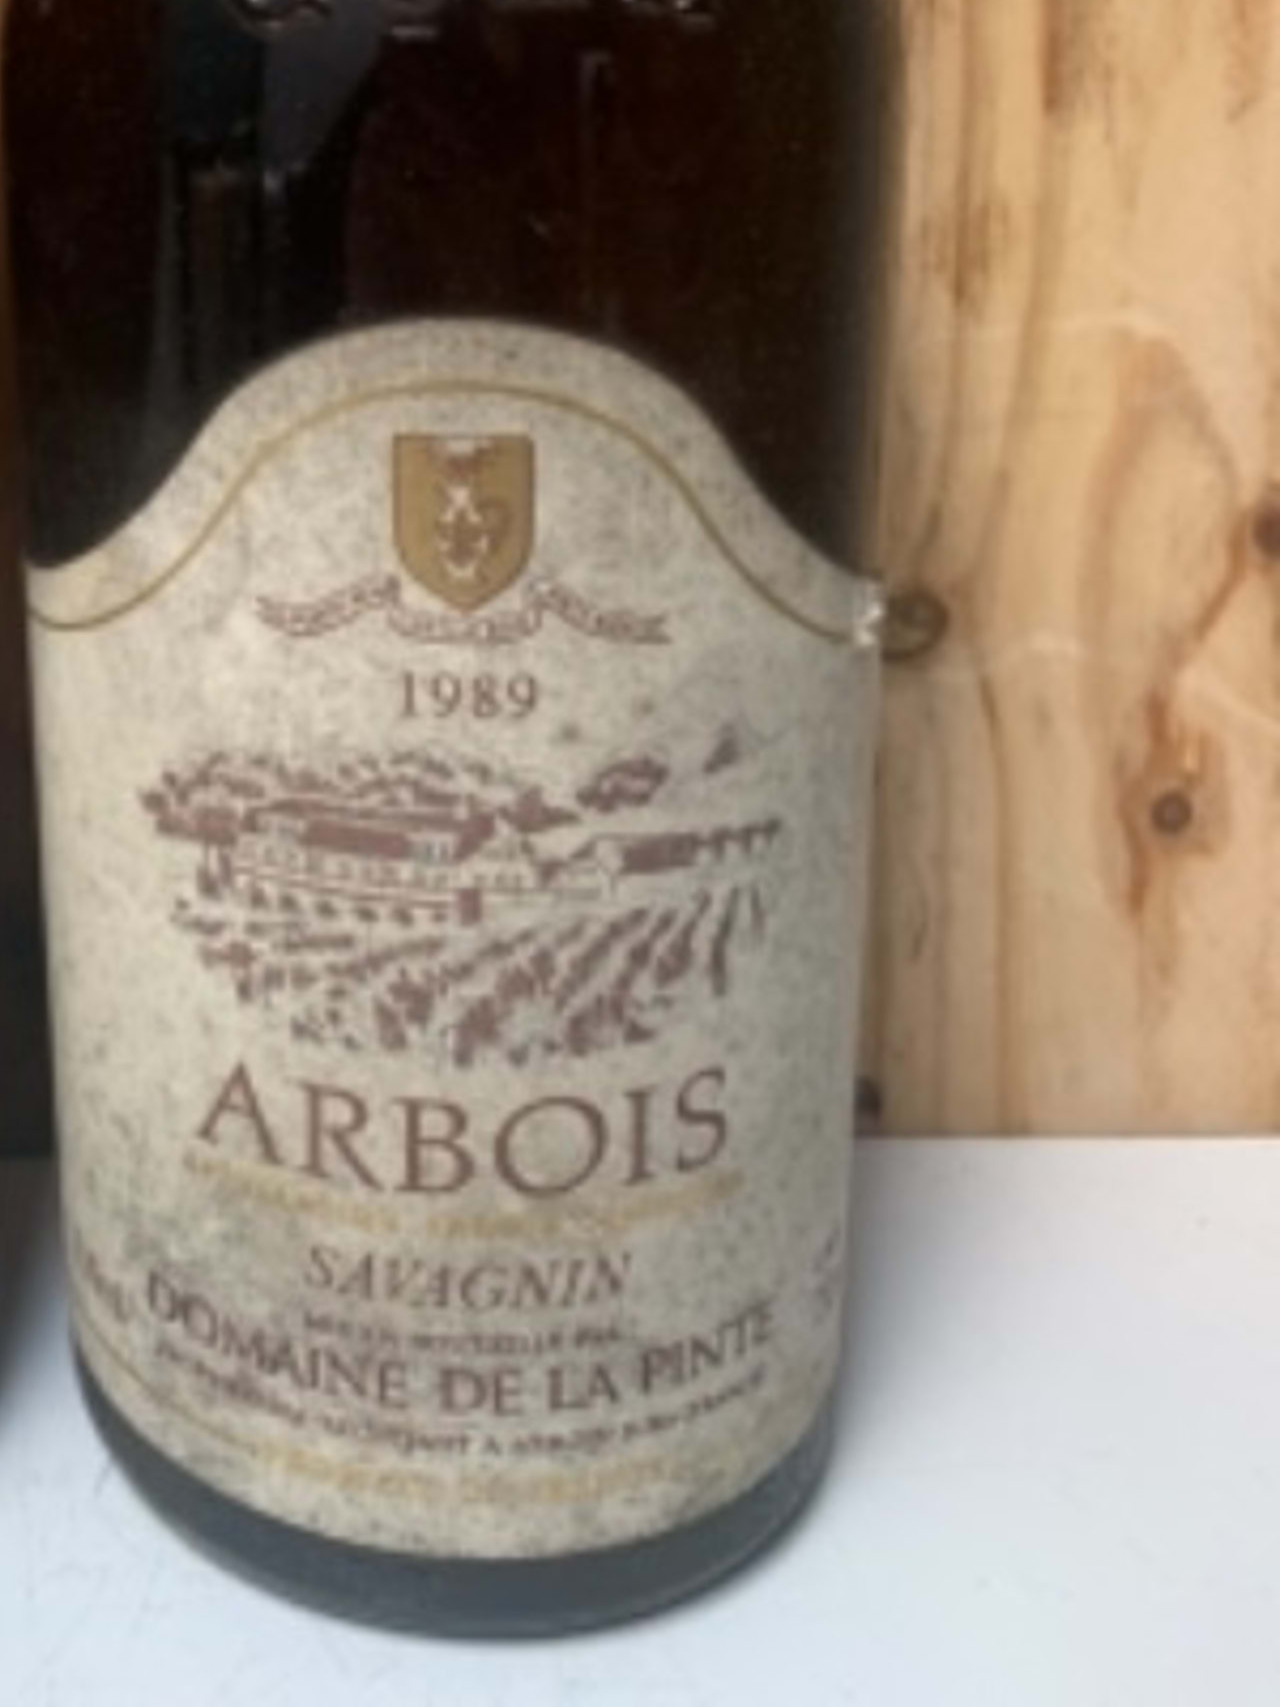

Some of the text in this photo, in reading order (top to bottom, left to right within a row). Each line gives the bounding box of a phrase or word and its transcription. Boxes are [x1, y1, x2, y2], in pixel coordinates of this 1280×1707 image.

[401, 670, 538, 719] 1989
[196, 1060, 729, 1198] ARBOIS
[310, 1246, 631, 1310] SAVAGNIN
[147, 1270, 411, 1411] DOMAINE
[438, 1365, 524, 1417] DE
[546, 1361, 620, 1413] LA
[640, 1302, 774, 1396] PINTE
